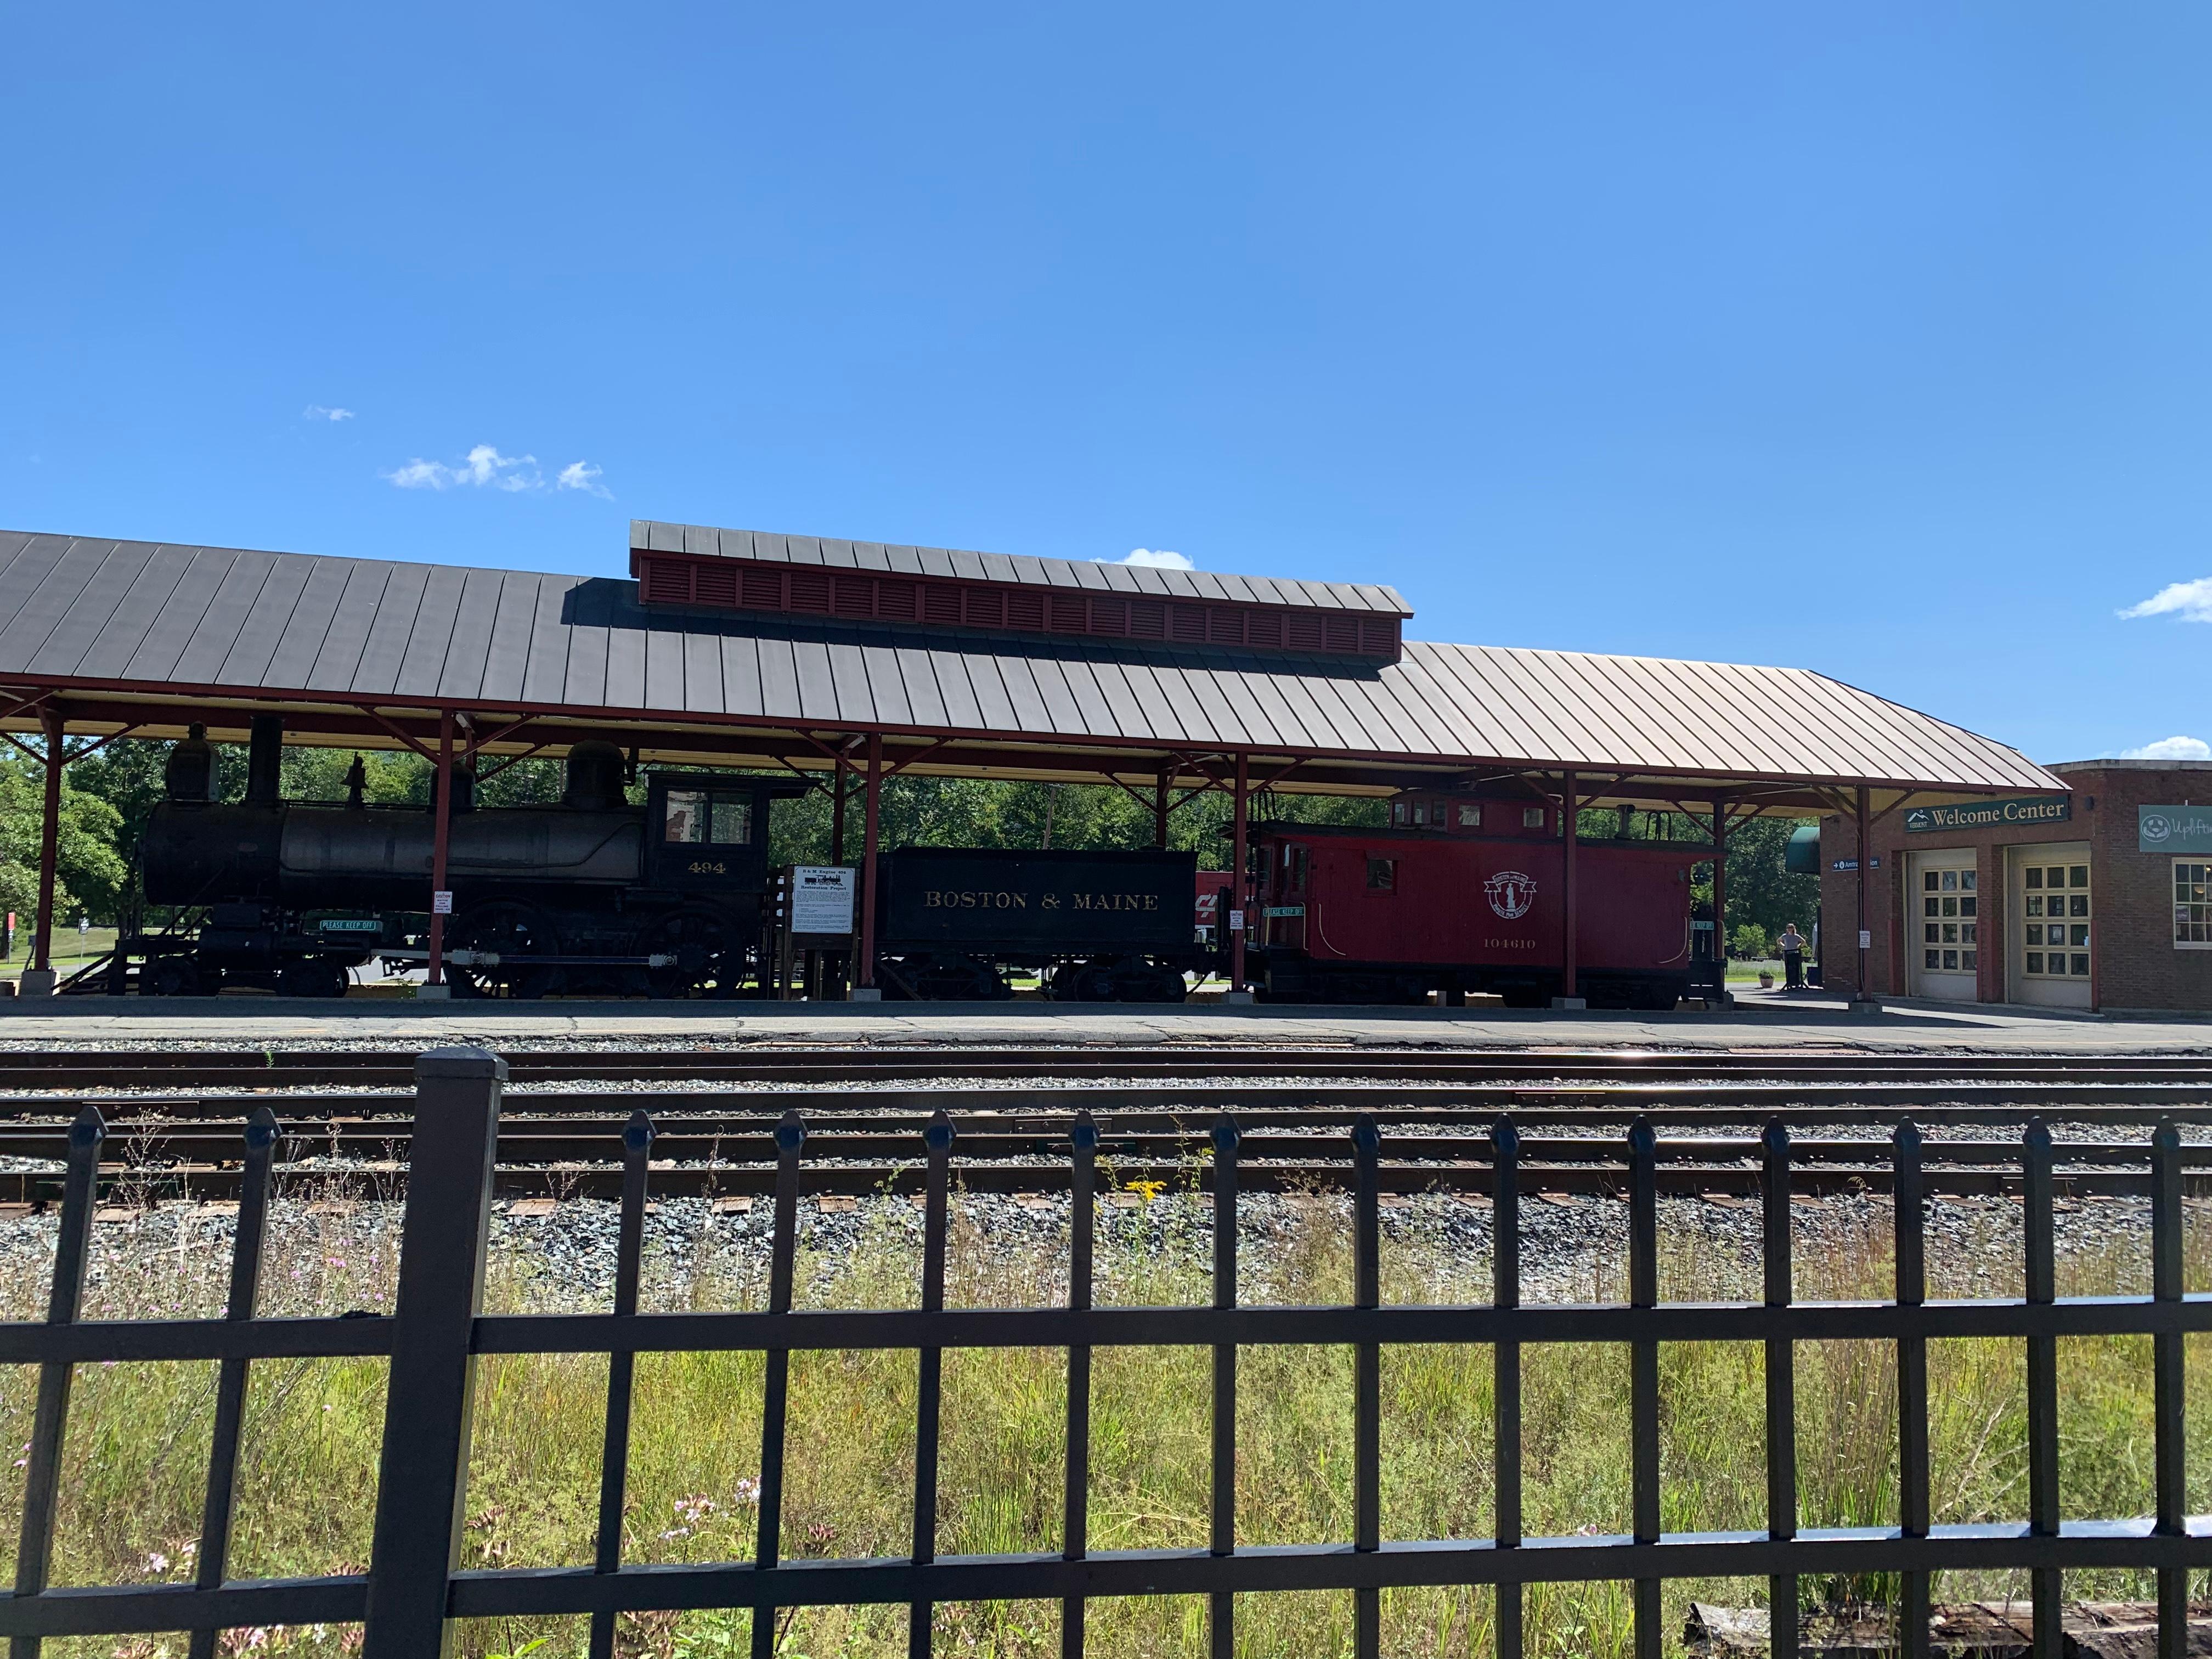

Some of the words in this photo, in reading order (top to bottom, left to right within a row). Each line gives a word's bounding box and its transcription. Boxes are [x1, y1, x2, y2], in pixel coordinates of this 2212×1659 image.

[1932, 809, 2000, 826] Welcome
[2004, 803, 2064, 820] Center
[688, 862, 726, 874] 494
[923, 891, 1029, 909] BOSTON
[1042, 893, 1060, 909] &
[1073, 894, 1159, 911] MAINE
[1485, 938, 1536, 949] 104610
